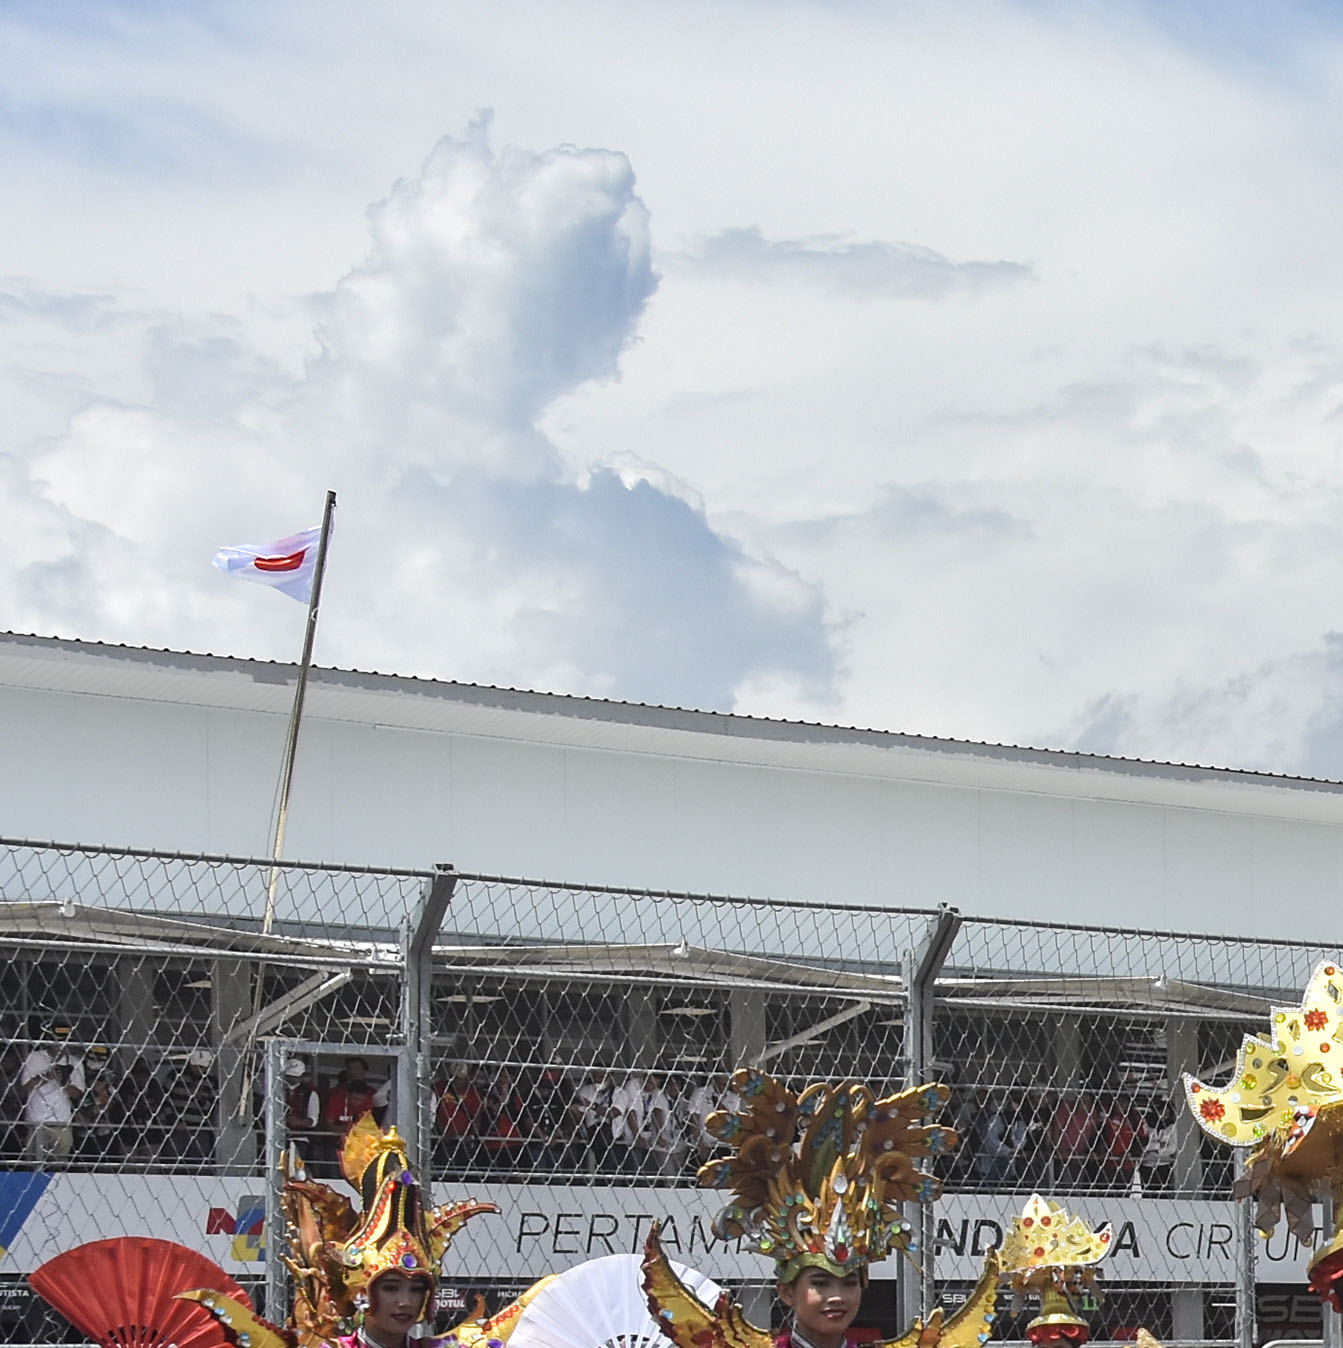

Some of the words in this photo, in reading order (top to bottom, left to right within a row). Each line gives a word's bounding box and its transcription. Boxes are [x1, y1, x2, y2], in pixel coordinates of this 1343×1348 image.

[516, 1212, 752, 1255] PERTAM
[1166, 1222, 1324, 1262] CIRUIT
[497, 1290, 523, 1298] MICHA
[435, 1299, 466, 1308] OTUL
